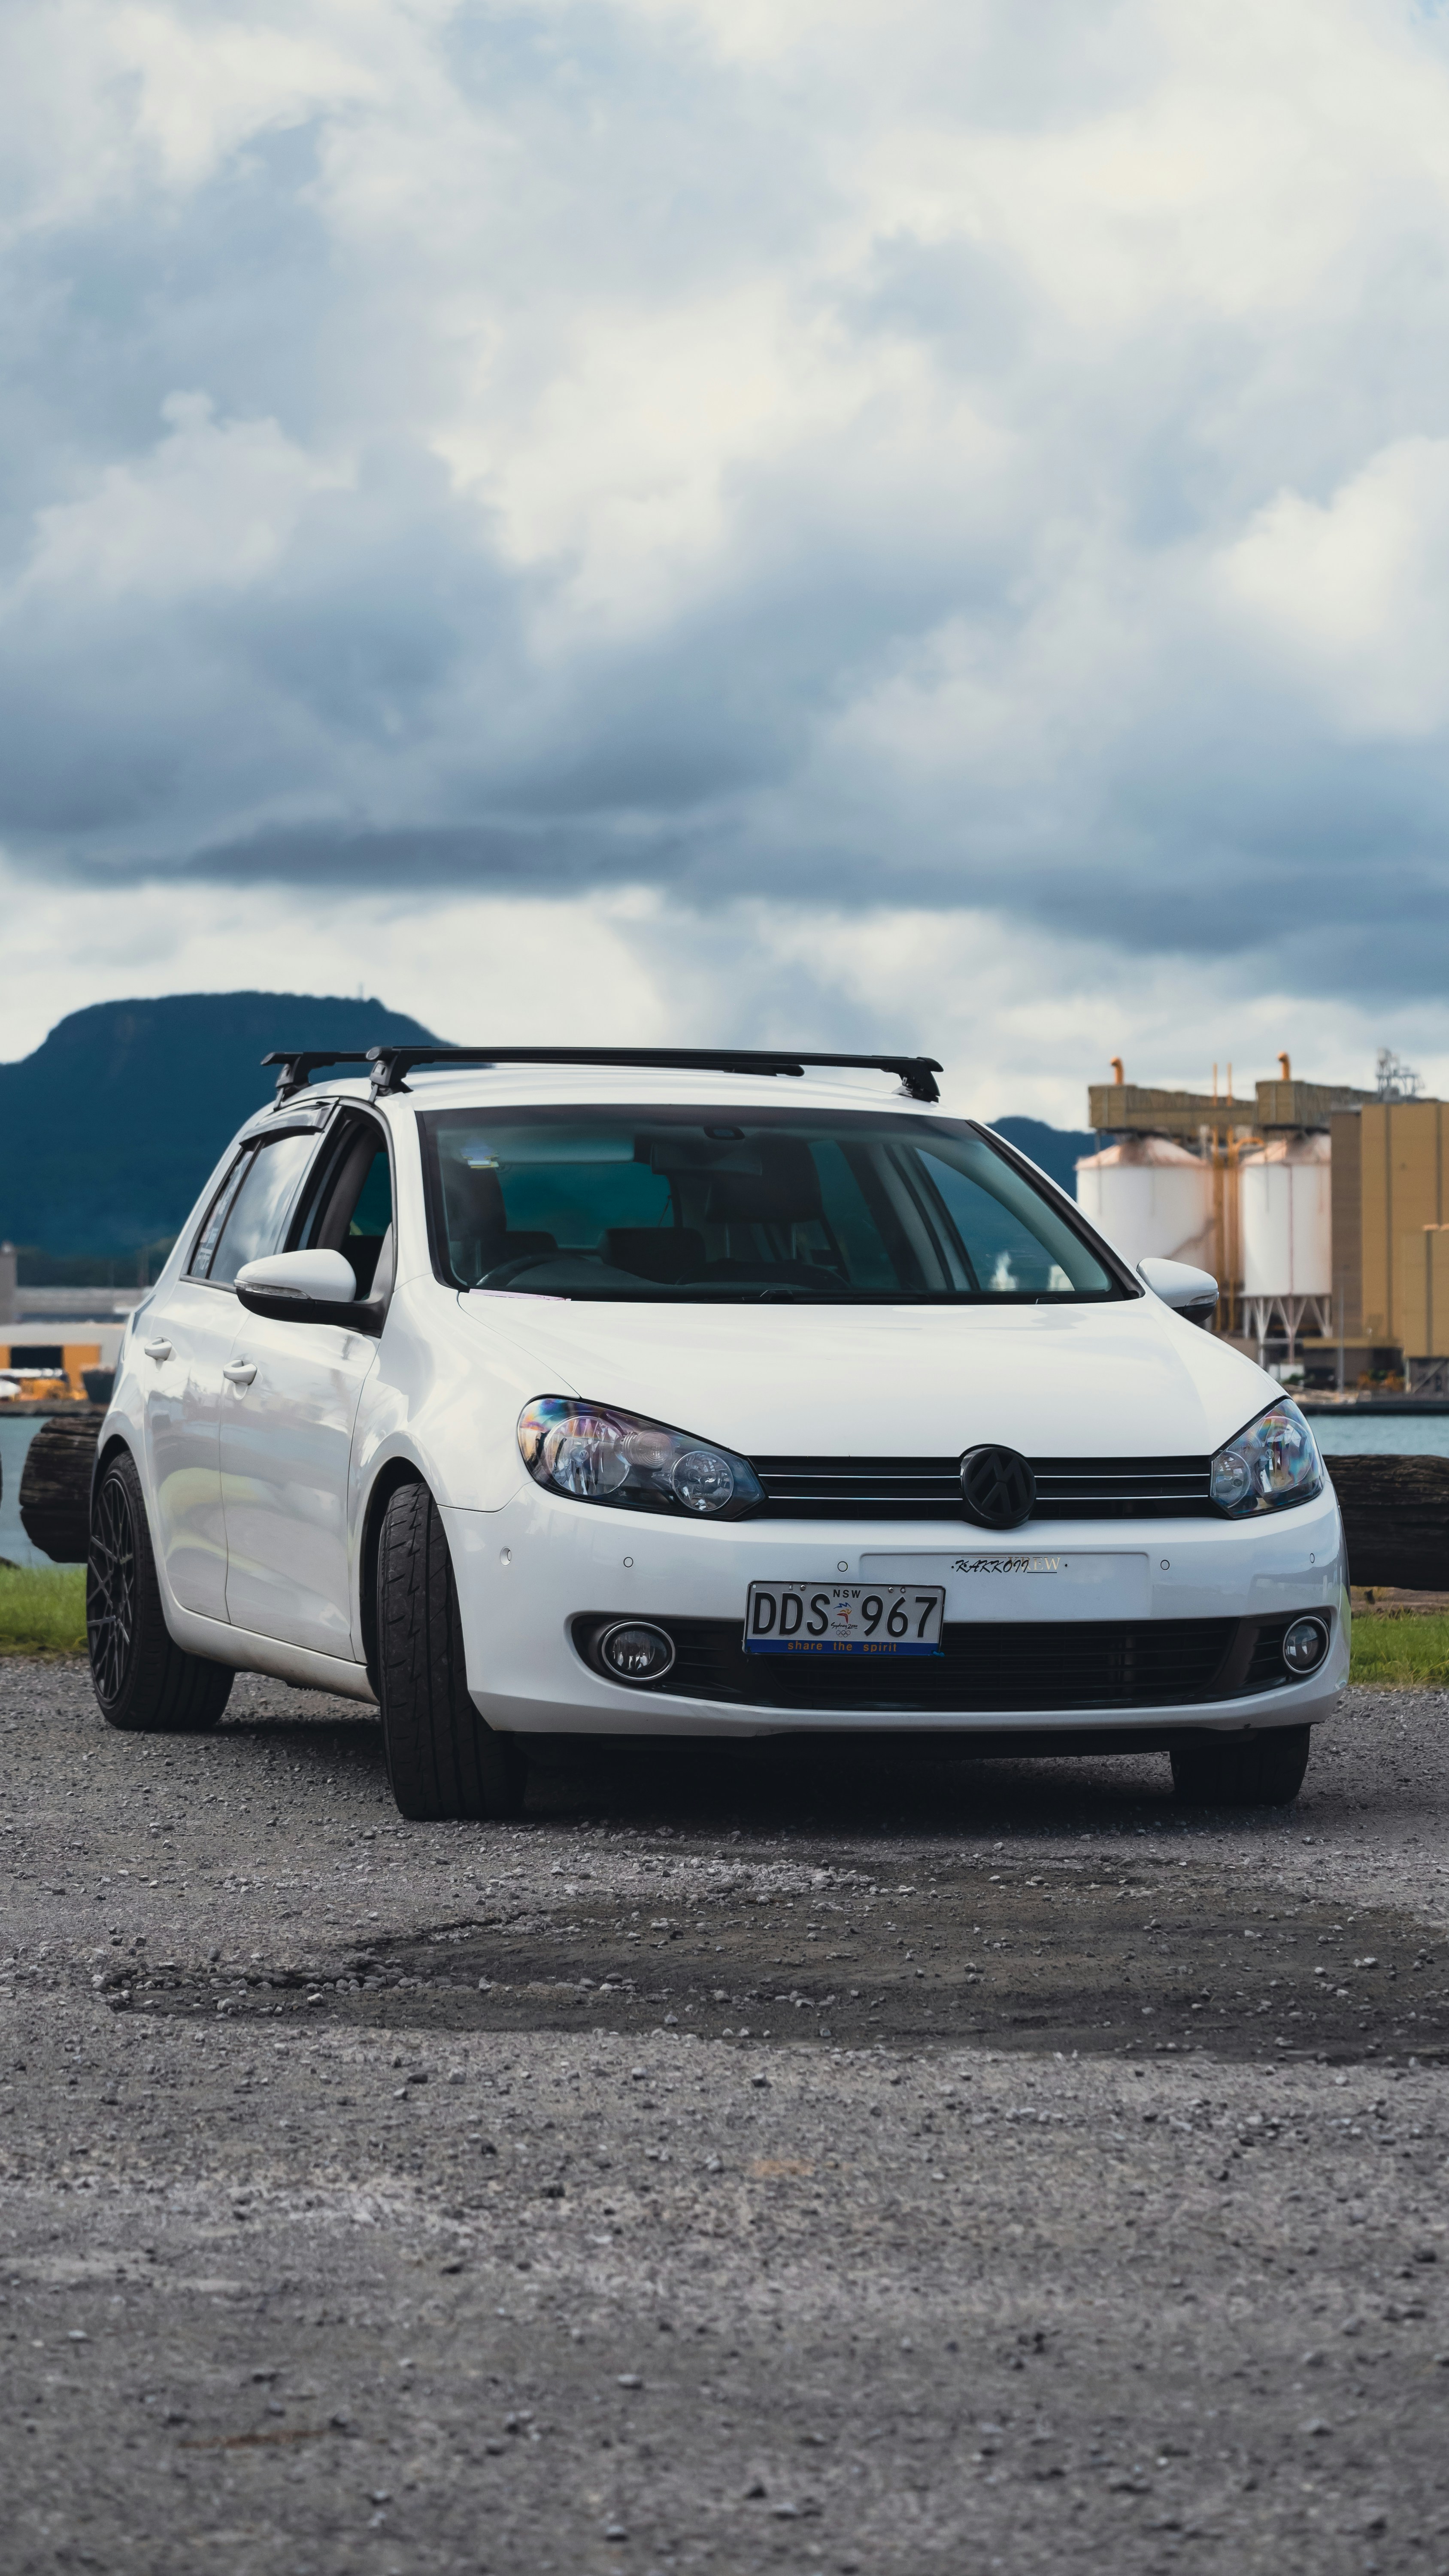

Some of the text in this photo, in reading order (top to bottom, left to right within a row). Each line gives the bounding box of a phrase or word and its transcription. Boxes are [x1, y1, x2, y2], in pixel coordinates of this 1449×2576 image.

[833, 1589, 861, 1598] NSW
[752, 1592, 938, 1637] DDS 967
[788, 1640, 897, 1652] share the spirit
